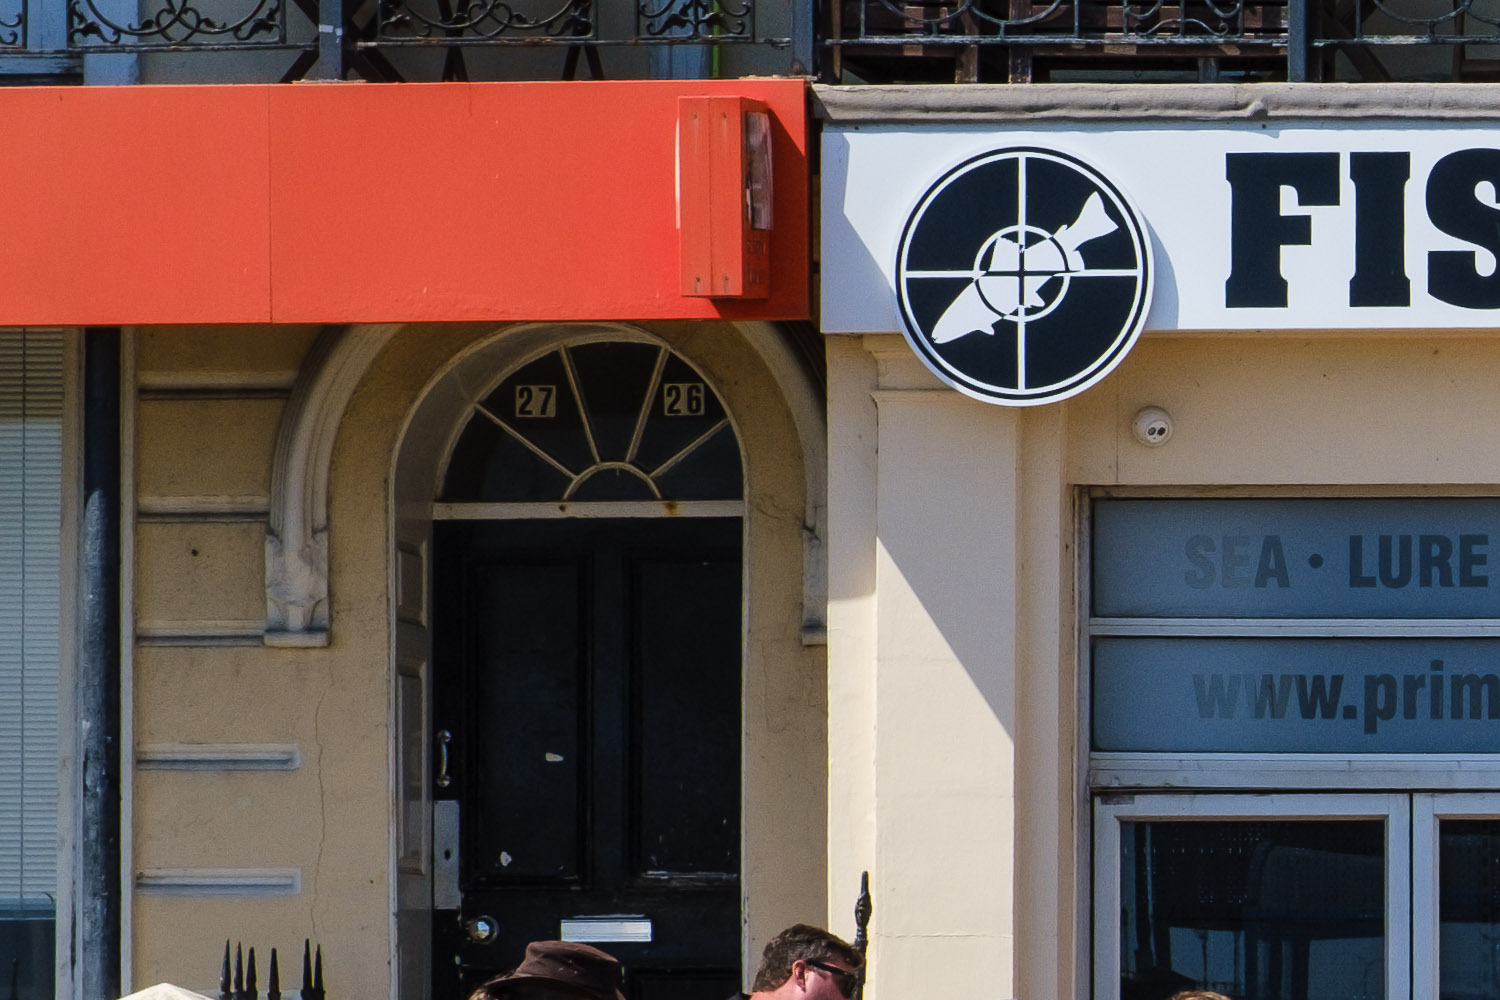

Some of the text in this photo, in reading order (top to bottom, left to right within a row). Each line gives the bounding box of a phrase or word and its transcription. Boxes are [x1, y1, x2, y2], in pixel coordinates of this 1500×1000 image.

[518, 386, 554, 416] 27
[666, 384, 702, 415] 26
[1184, 534, 1291, 589] SEA
[1349, 533, 1490, 589] LURE
